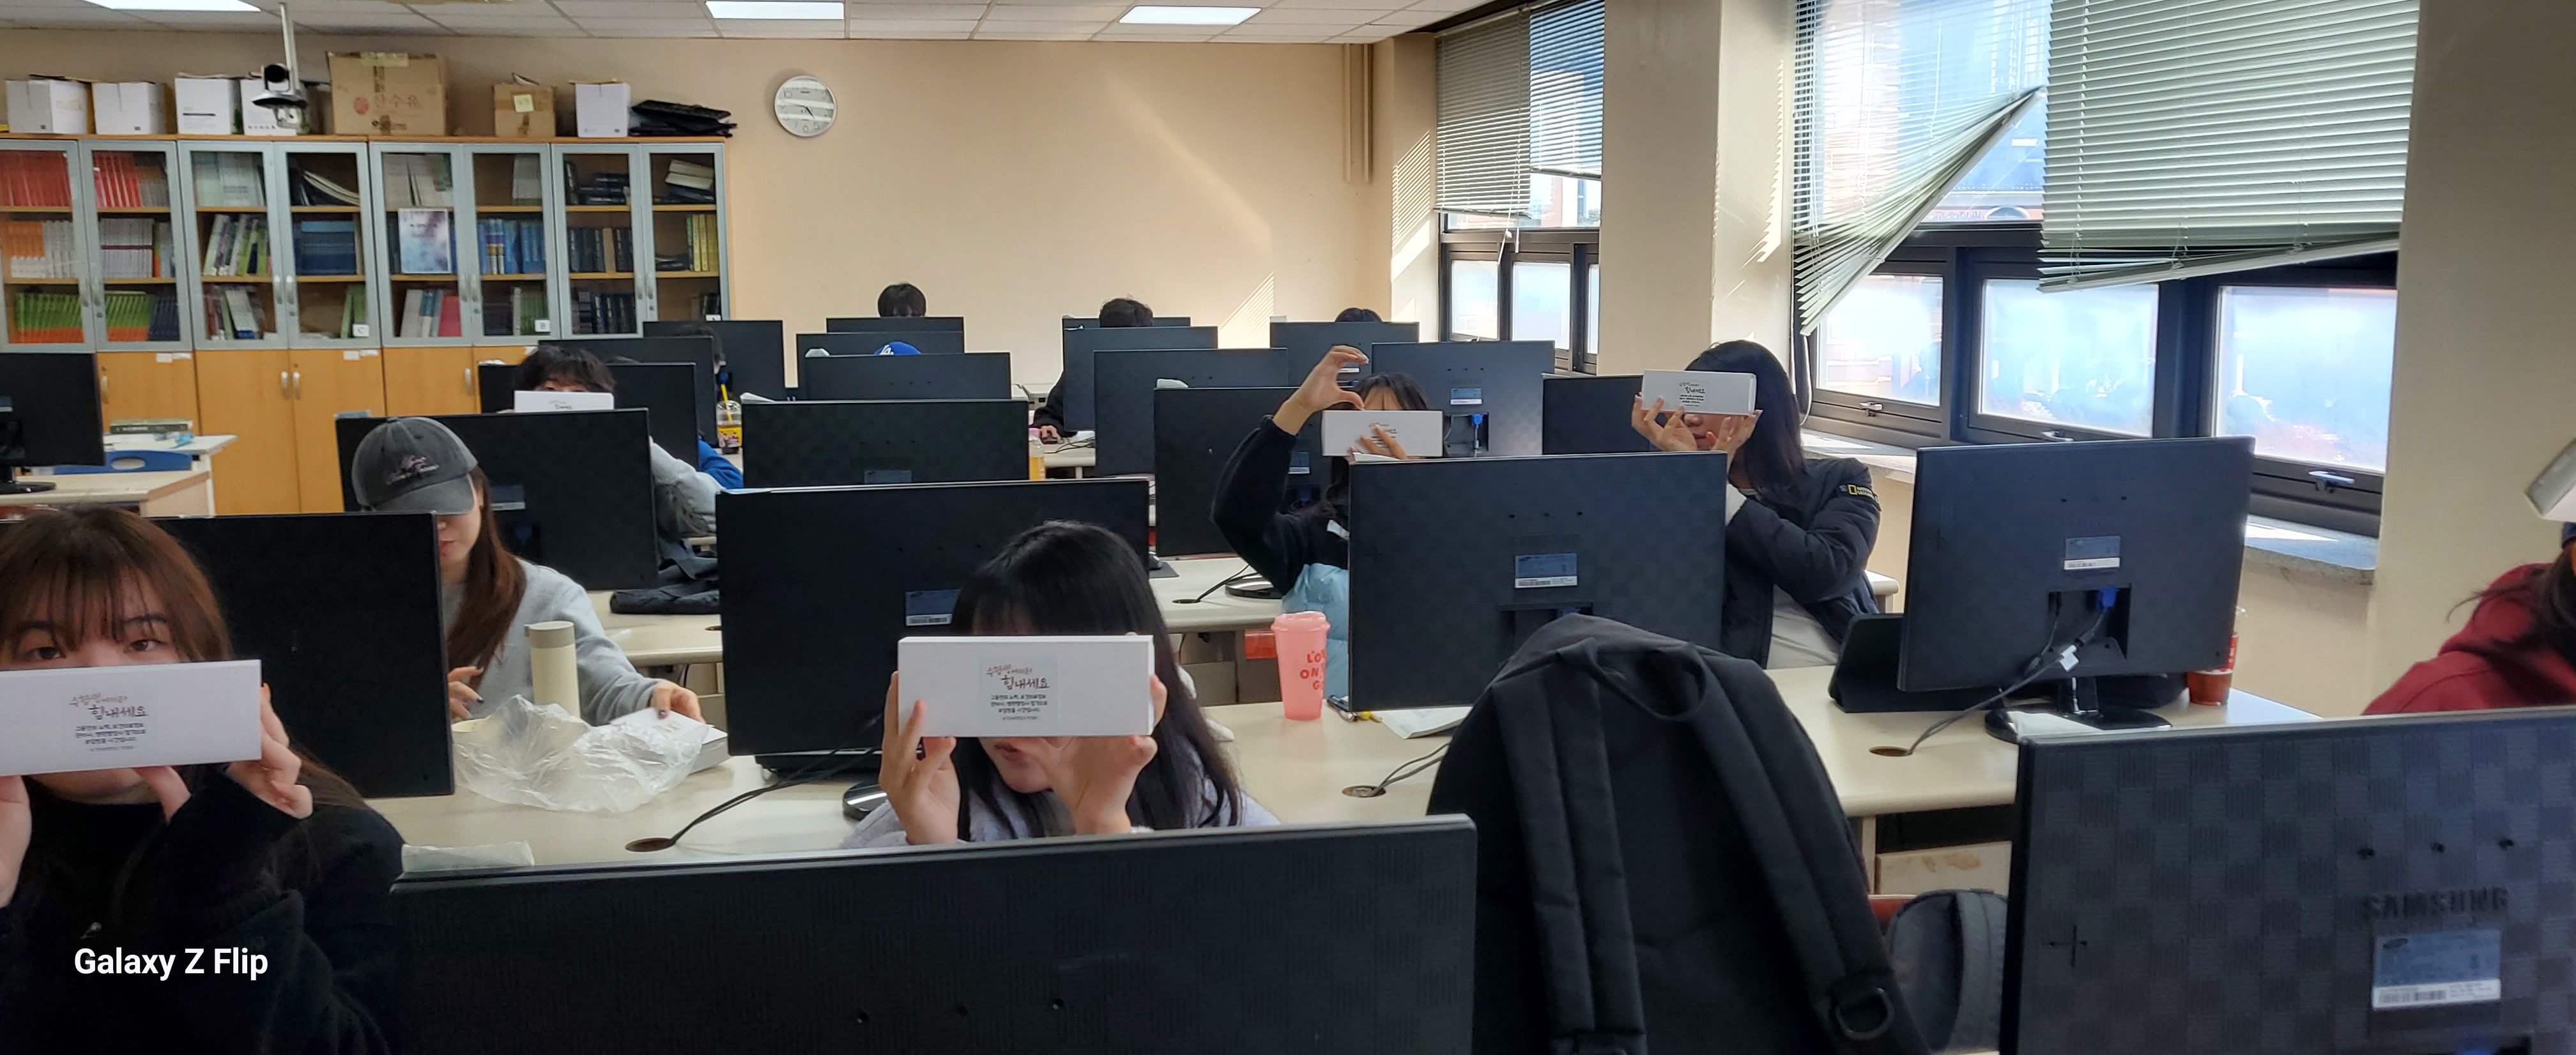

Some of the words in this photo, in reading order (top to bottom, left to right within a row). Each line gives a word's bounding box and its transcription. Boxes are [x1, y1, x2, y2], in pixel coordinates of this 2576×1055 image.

[1300, 668, 1319, 679] ON
[1000, 674, 1050, 690] 힘내세요
[87, 704, 148, 720] 힘내세요
